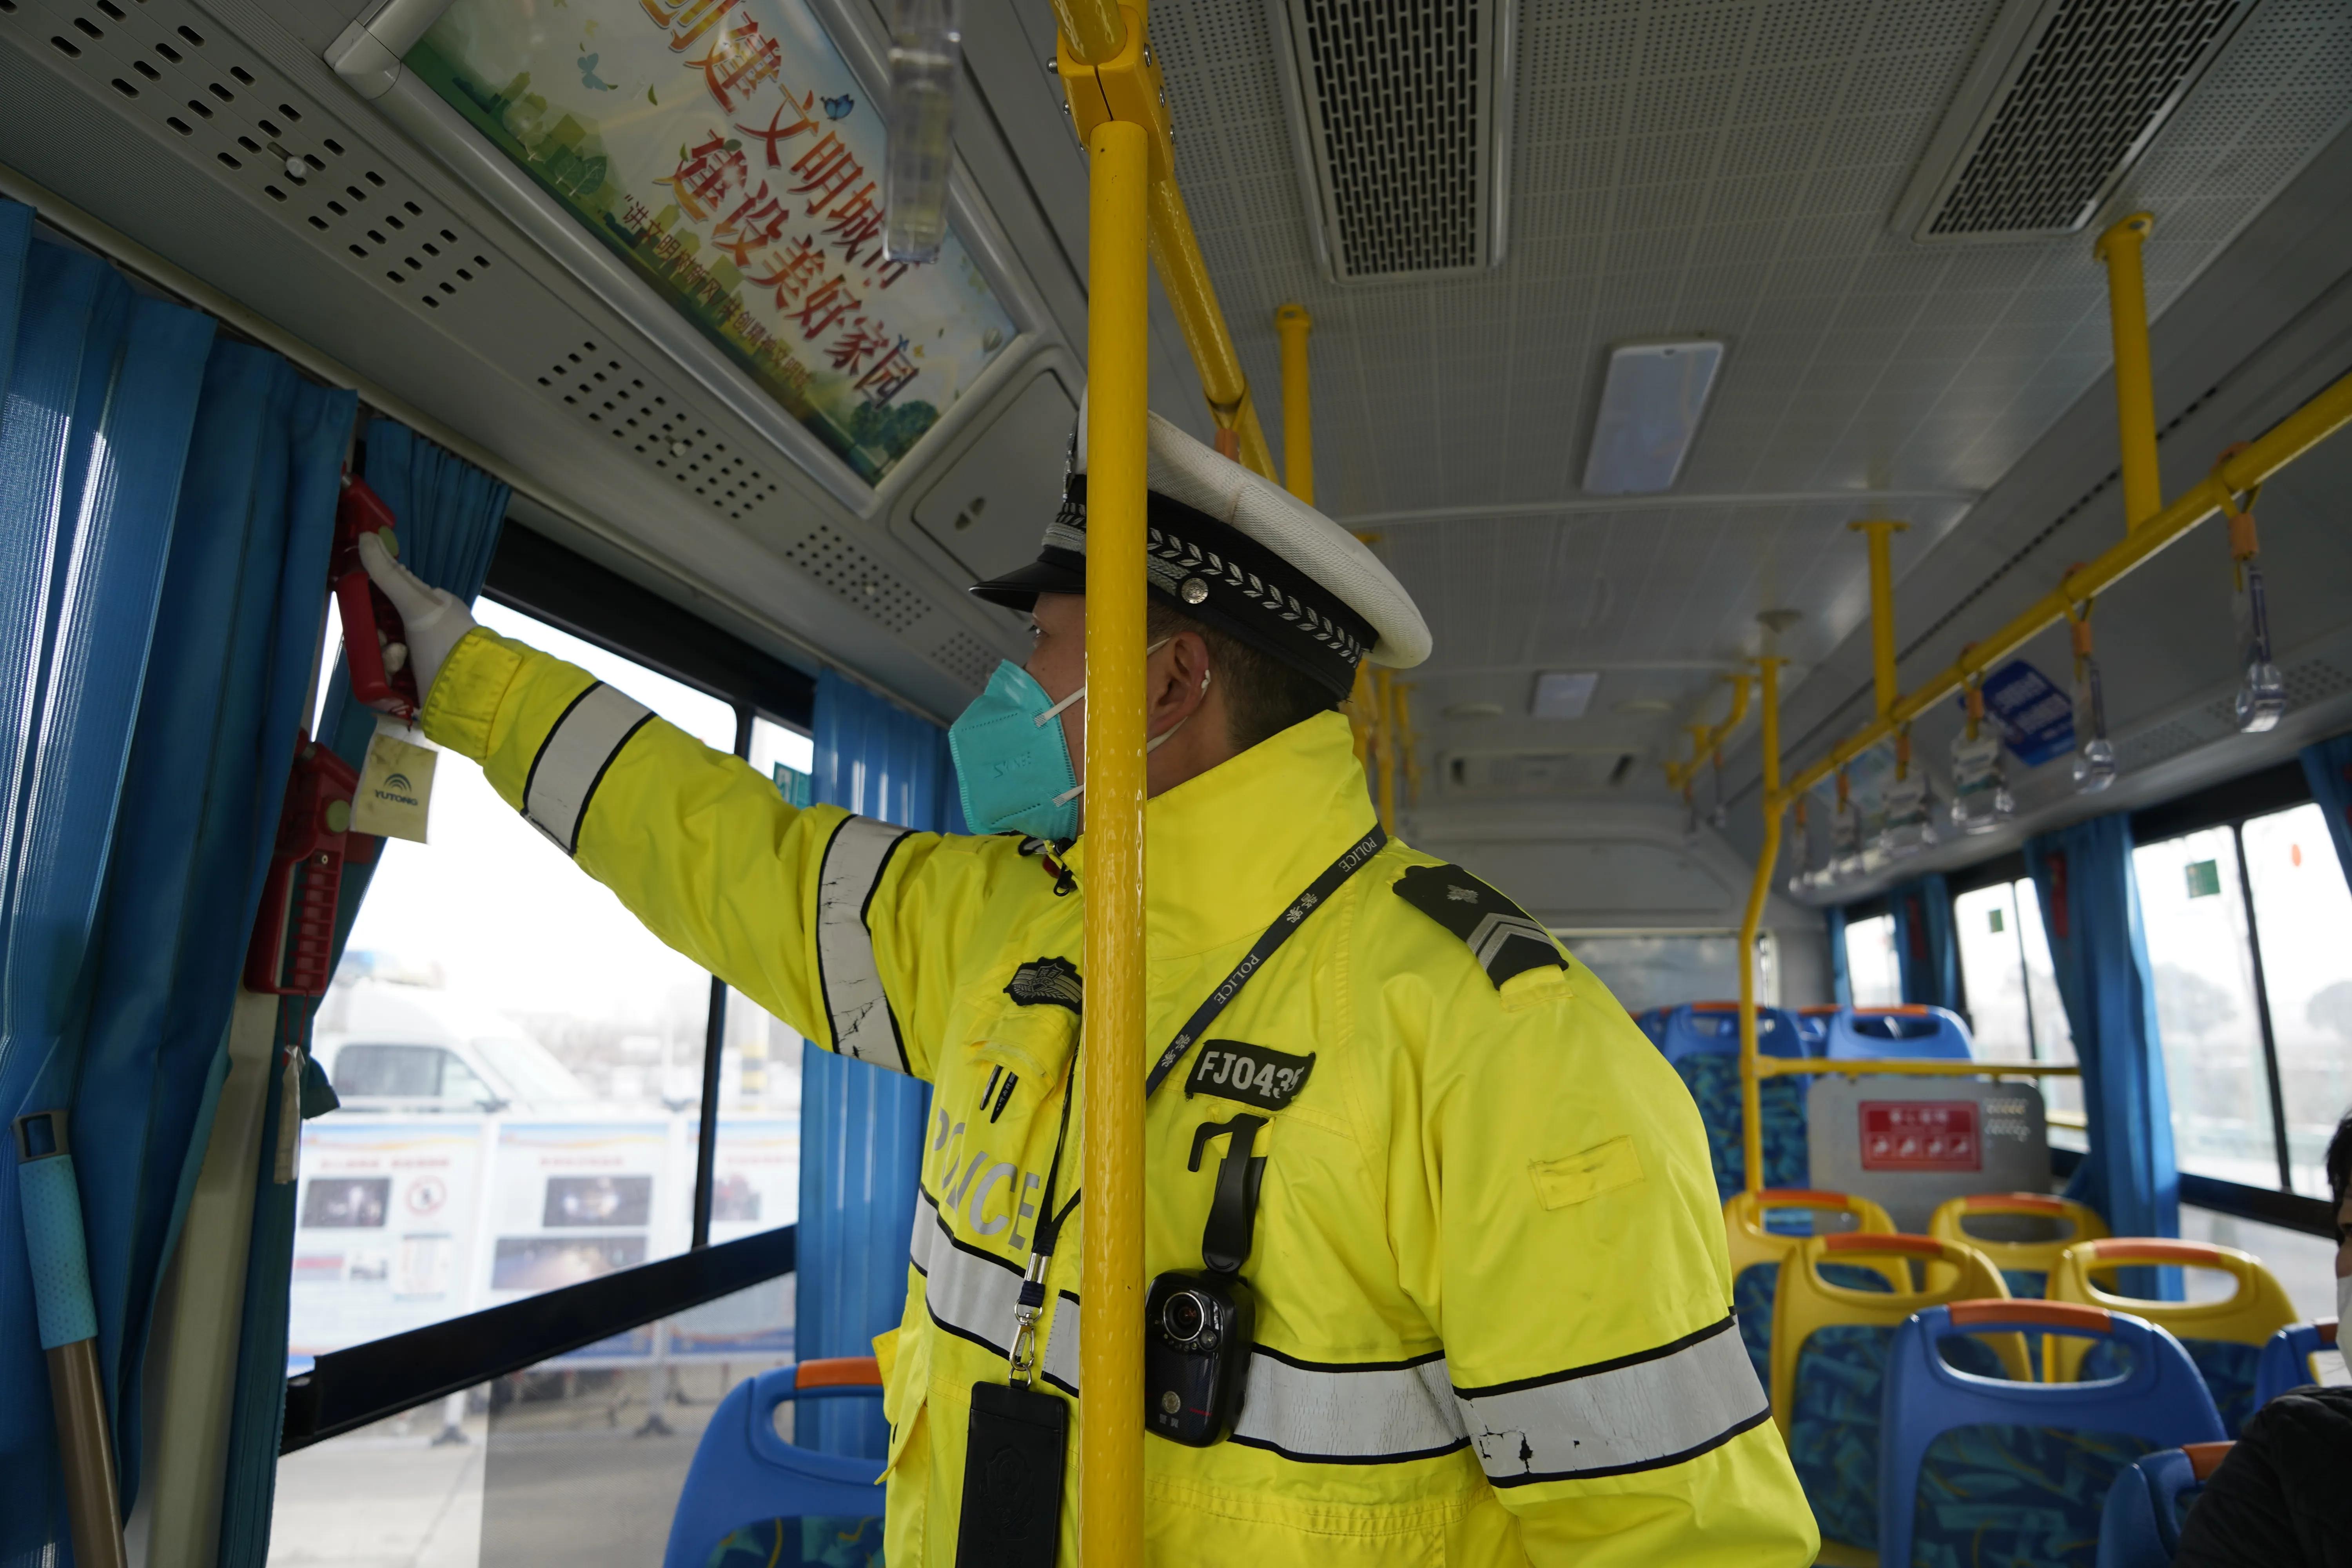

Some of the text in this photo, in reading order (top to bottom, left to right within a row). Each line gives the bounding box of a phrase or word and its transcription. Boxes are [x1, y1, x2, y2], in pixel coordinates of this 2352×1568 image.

[653, 129, 919, 411] 建设美好家园
[375, 789, 418, 806] YUTONG
[1338, 837, 1377, 872] POLICE
[1286, 893, 1318, 923] 警察
[1214, 953, 1261, 1004] POLICE
[933, 1106, 1040, 1251] POICE
